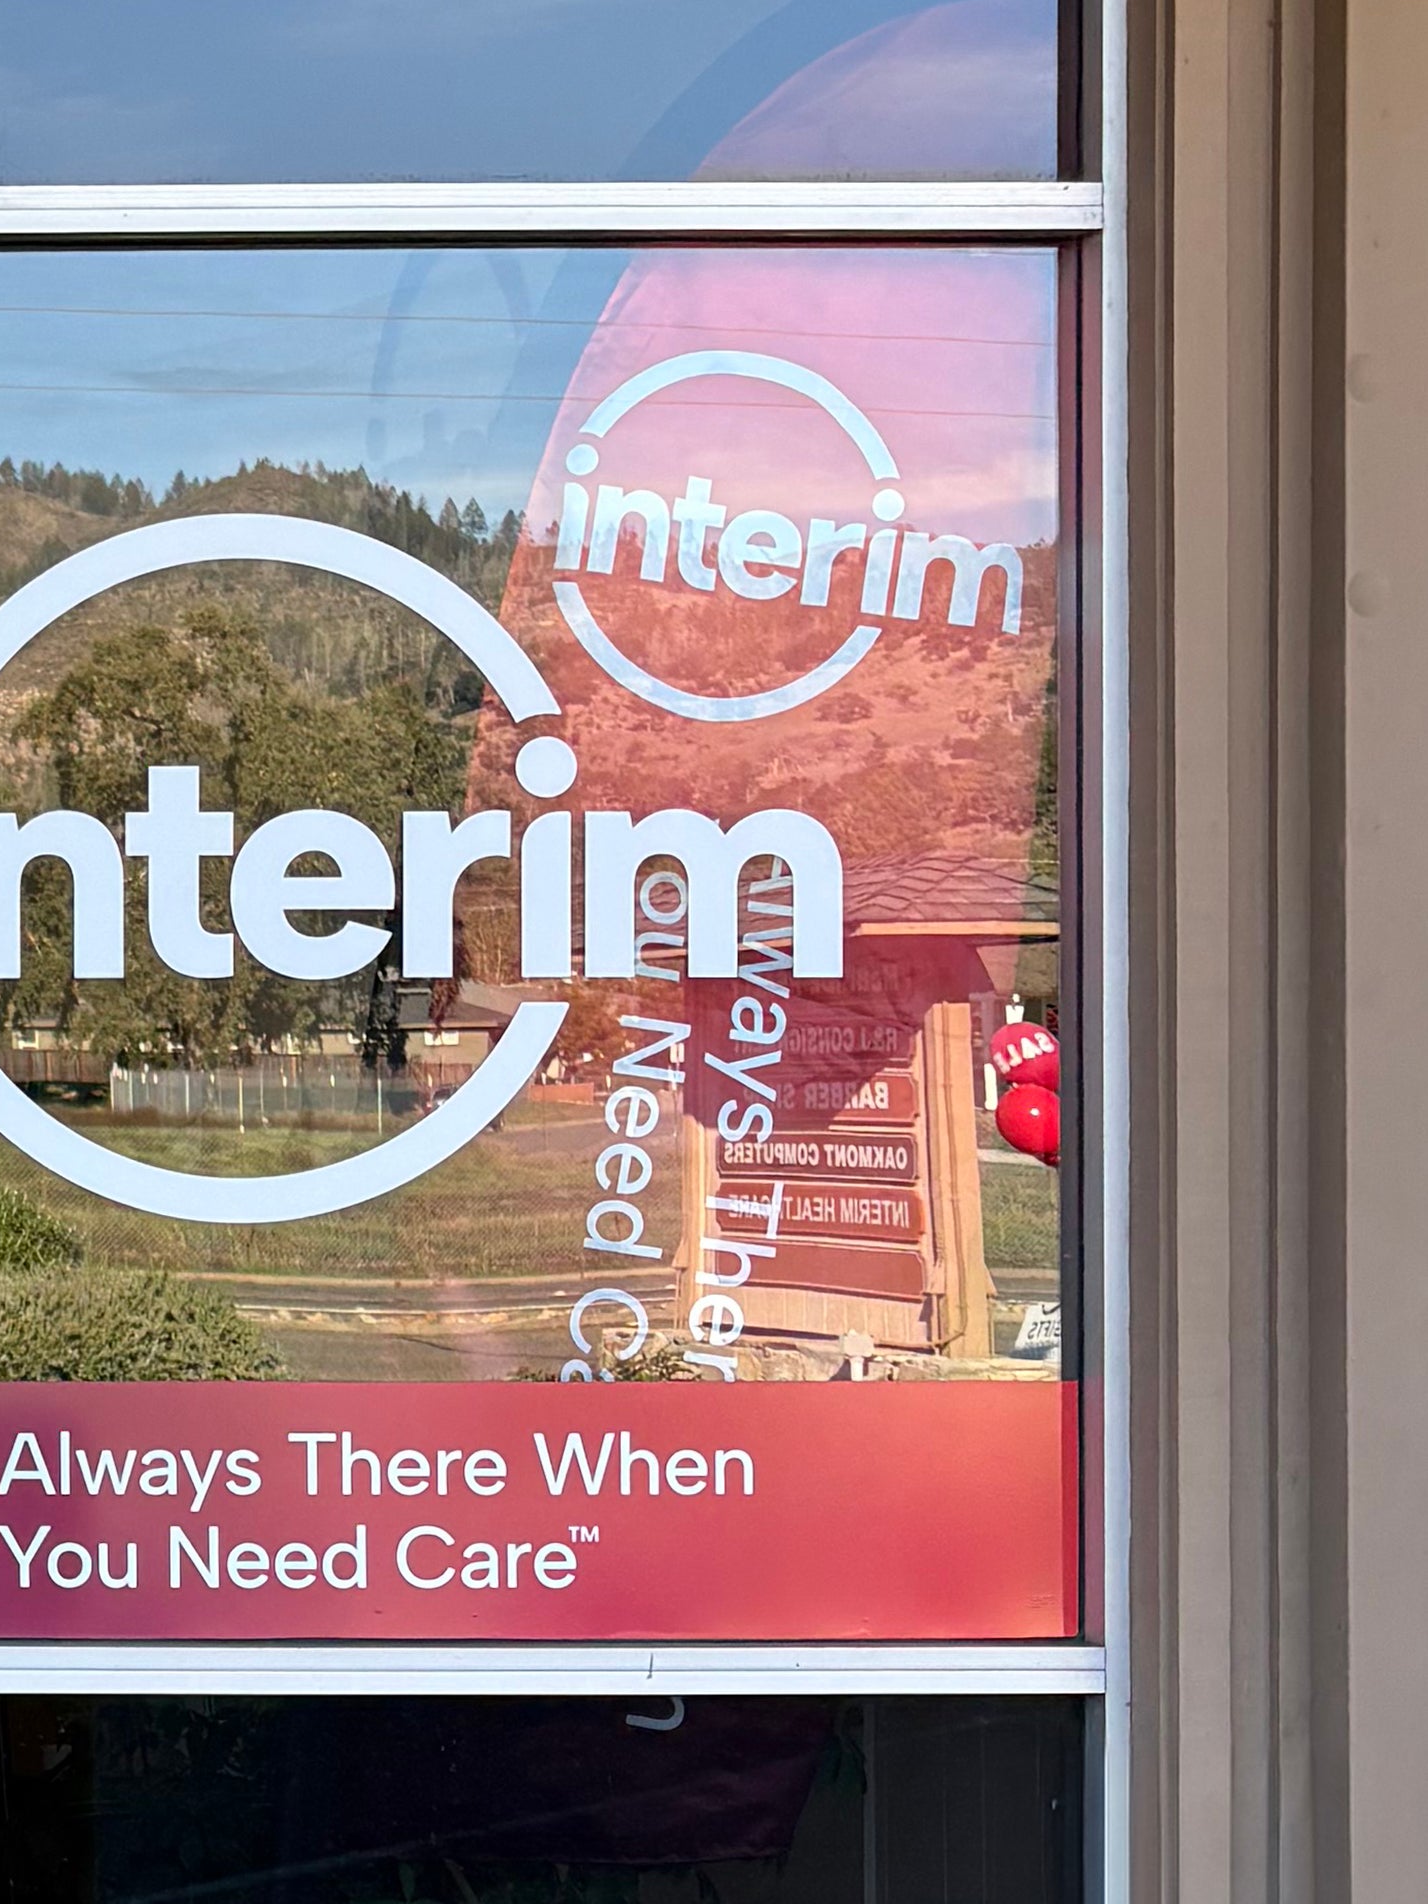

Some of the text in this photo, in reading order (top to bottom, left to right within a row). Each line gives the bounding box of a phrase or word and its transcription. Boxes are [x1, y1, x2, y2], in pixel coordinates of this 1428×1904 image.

[553, 443, 1024, 636] interim
[584, 1014, 692, 1259] Need
[683, 1181, 785, 1382] Ther
[169, 1524, 367, 1589] Need
[287, 1431, 508, 1496] There
[533, 1431, 754, 1496] When
